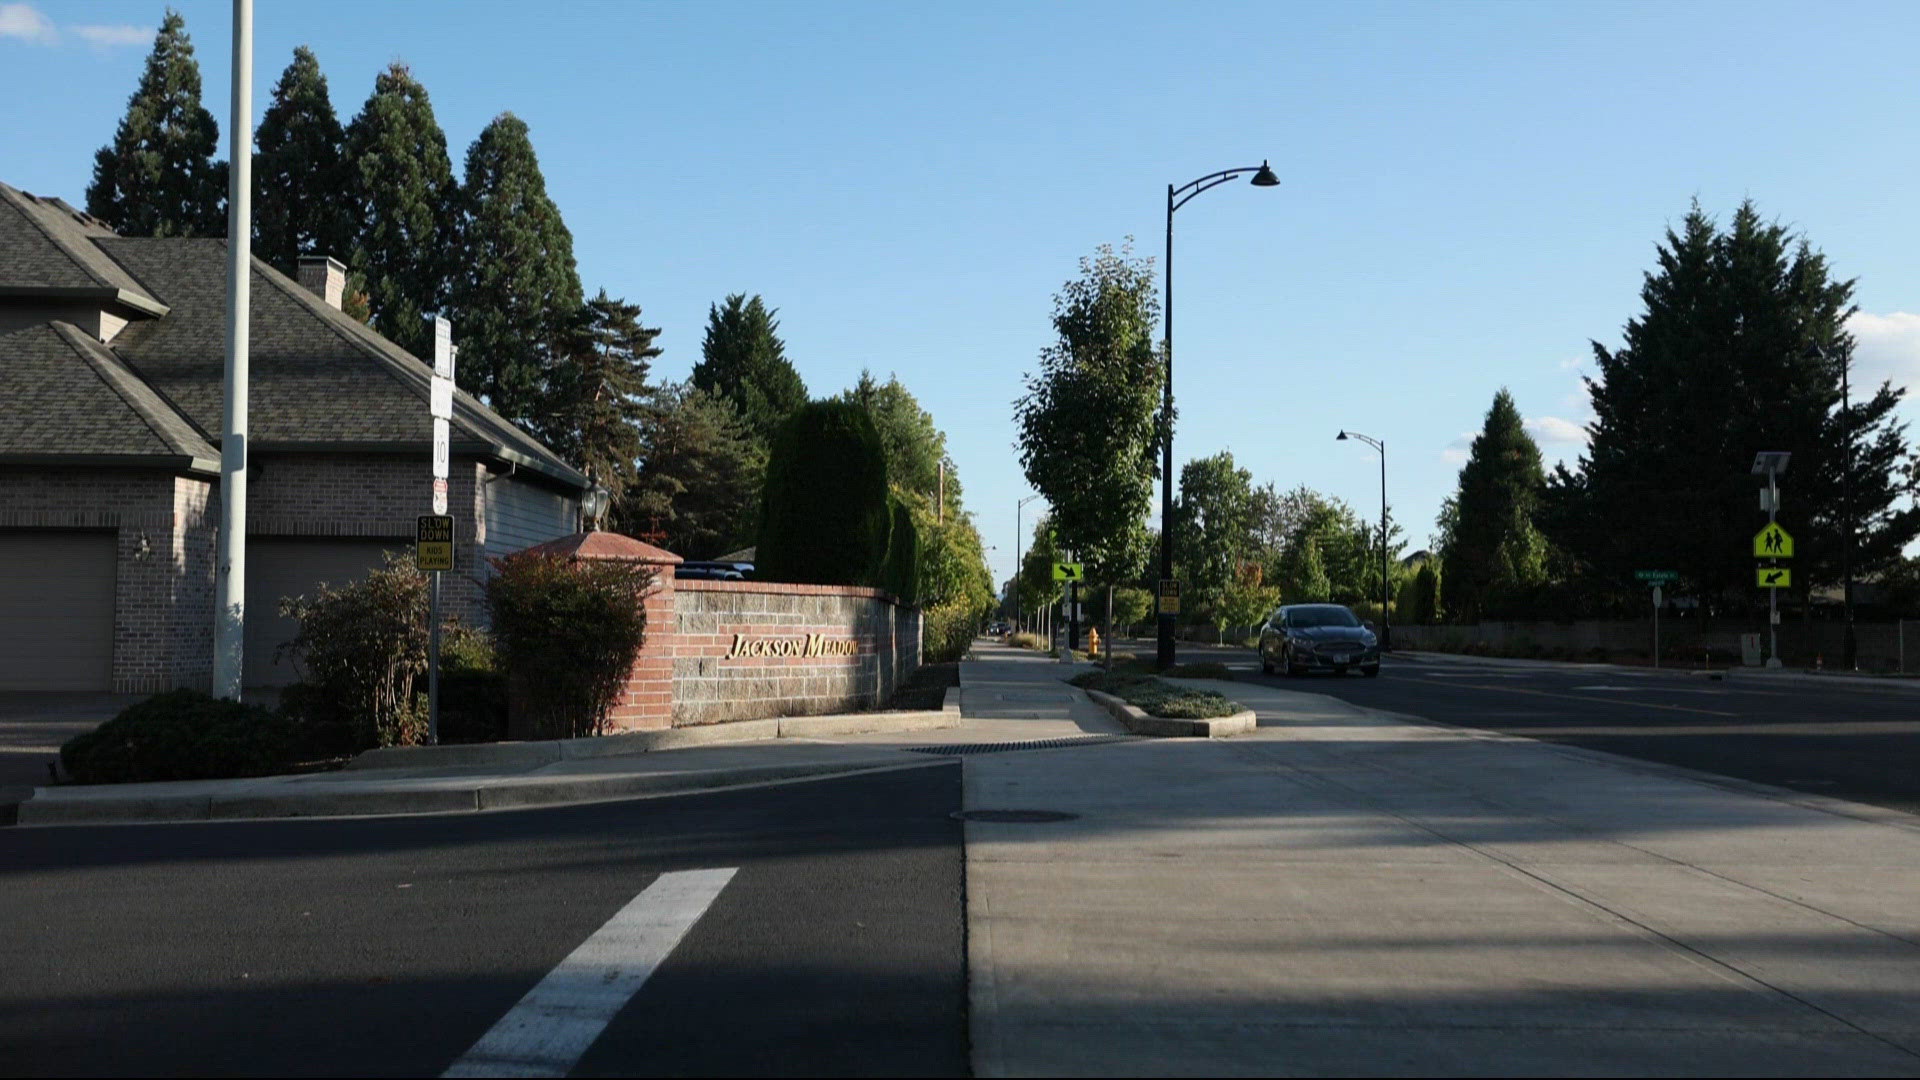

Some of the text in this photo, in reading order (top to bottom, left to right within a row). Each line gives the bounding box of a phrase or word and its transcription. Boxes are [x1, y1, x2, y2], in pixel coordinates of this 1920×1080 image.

[436, 441, 446, 464] 10
[420, 518, 449, 529] SLOW
[420, 530, 449, 541] DOWN
[427, 546, 443, 555] KIDS
[419, 556, 449, 565] PLAYING
[727, 633, 801, 659] JACKSON
